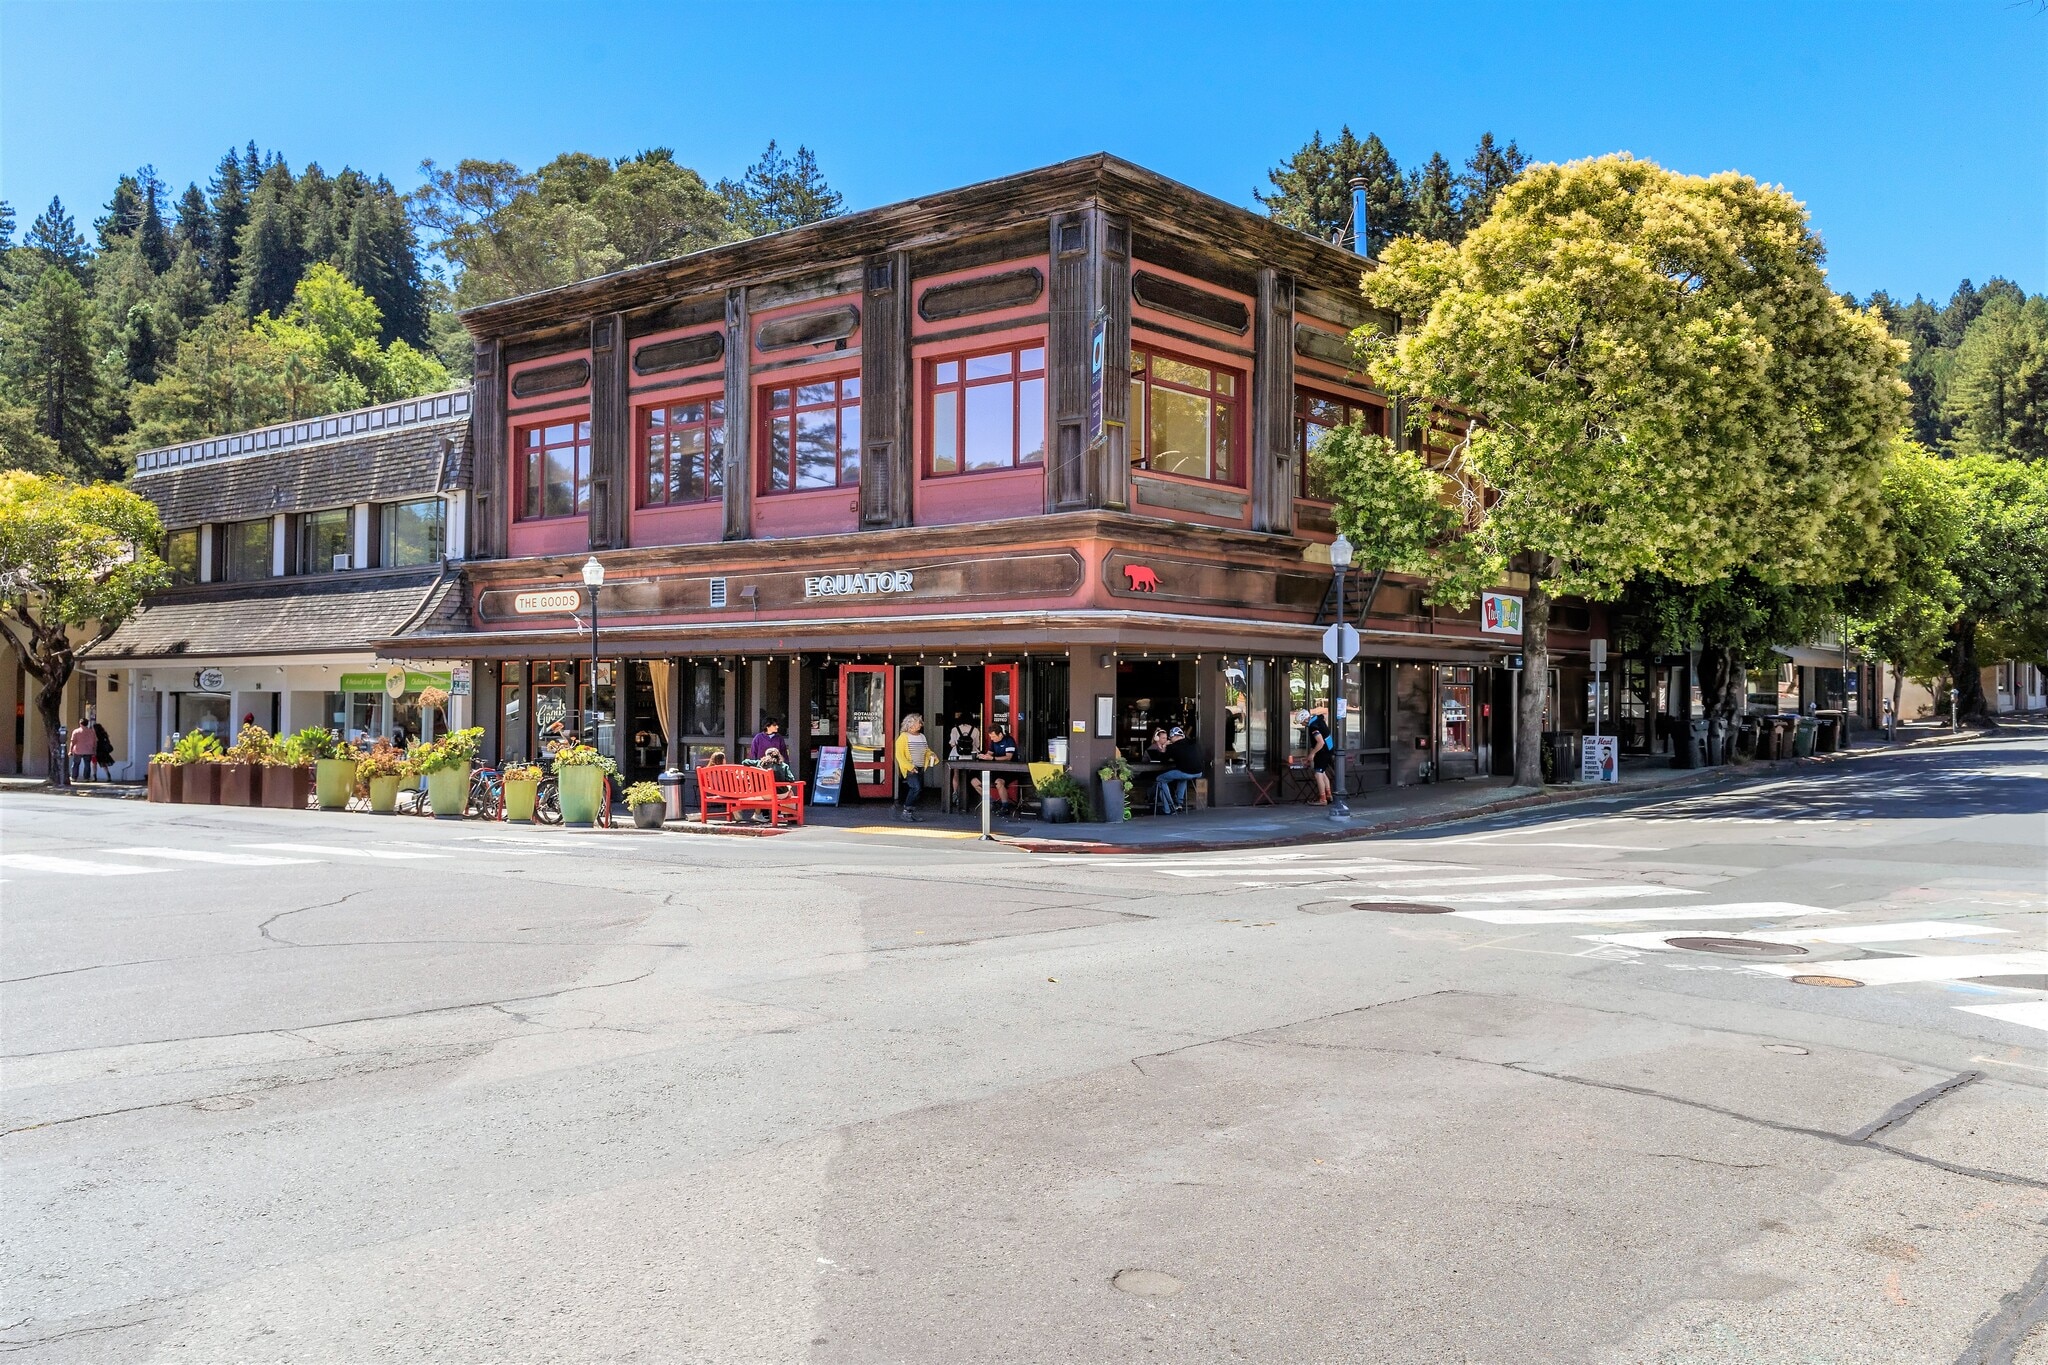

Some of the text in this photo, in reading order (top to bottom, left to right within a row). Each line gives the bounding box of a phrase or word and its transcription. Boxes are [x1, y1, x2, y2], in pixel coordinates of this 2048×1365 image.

[804, 569, 914, 598] EQUATOR
[519, 595, 575, 608] THE GOODS
[939, 656, 944, 664] 2
[536, 699, 567, 728] Goods
